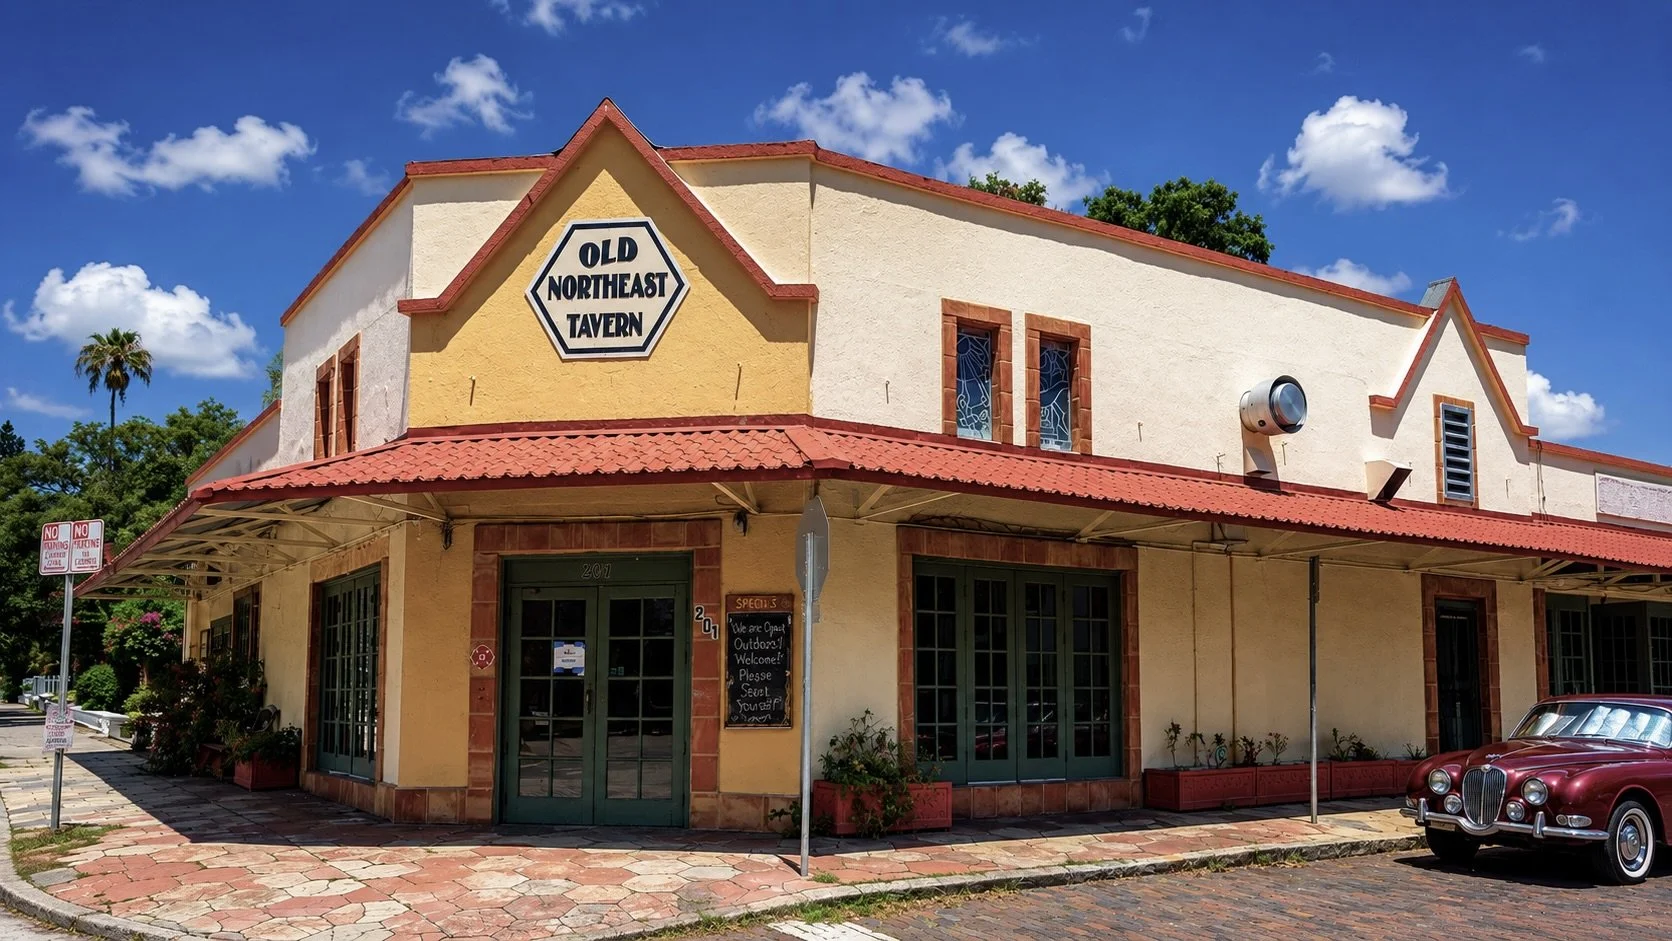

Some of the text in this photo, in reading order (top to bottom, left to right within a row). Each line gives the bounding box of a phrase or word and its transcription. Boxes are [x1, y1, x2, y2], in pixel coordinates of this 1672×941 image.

[578, 236, 639, 269] OLD
[547, 272, 669, 301] NORTHEAST
[566, 312, 644, 339] TAVERN
[44, 526, 59, 541] NO
[74, 523, 89, 539] NO
[694, 605, 719, 640] 201
